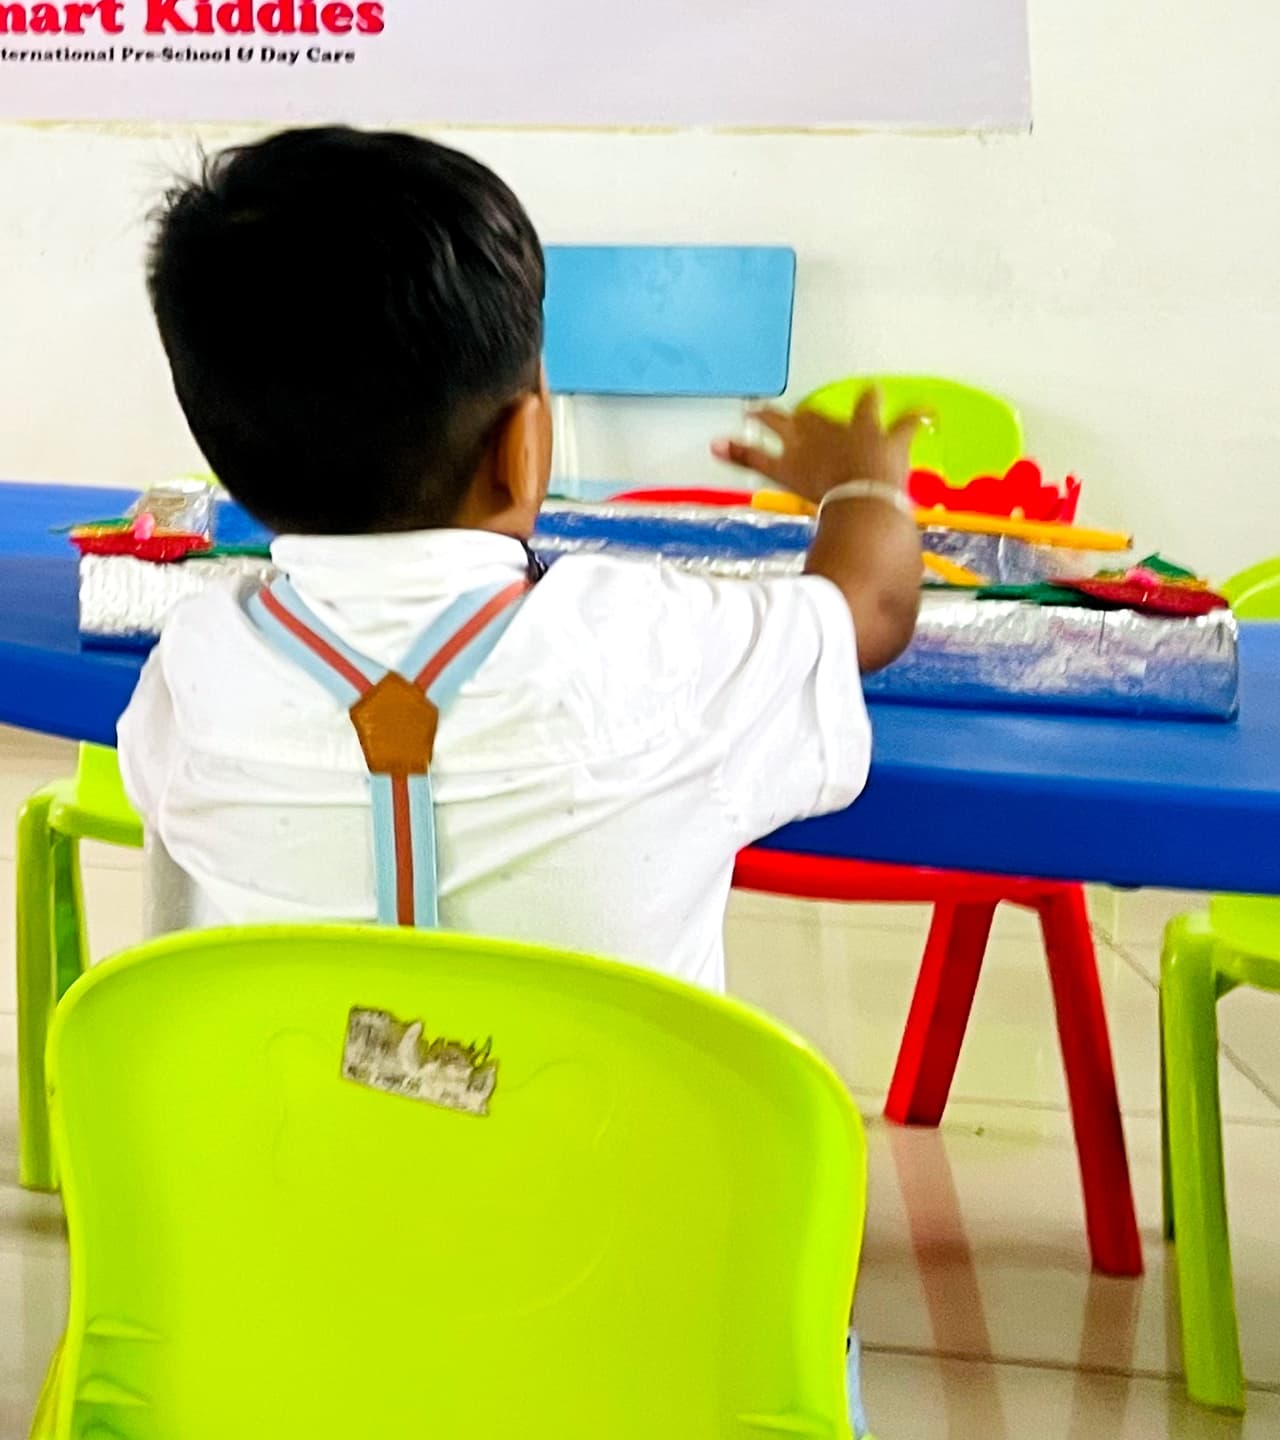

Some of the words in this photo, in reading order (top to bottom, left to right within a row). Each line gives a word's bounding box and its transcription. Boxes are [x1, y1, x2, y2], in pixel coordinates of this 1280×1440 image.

[121, 46, 231, 62] Pre-School
[260, 46, 300, 66] Day
[306, 46, 356, 63] Care
